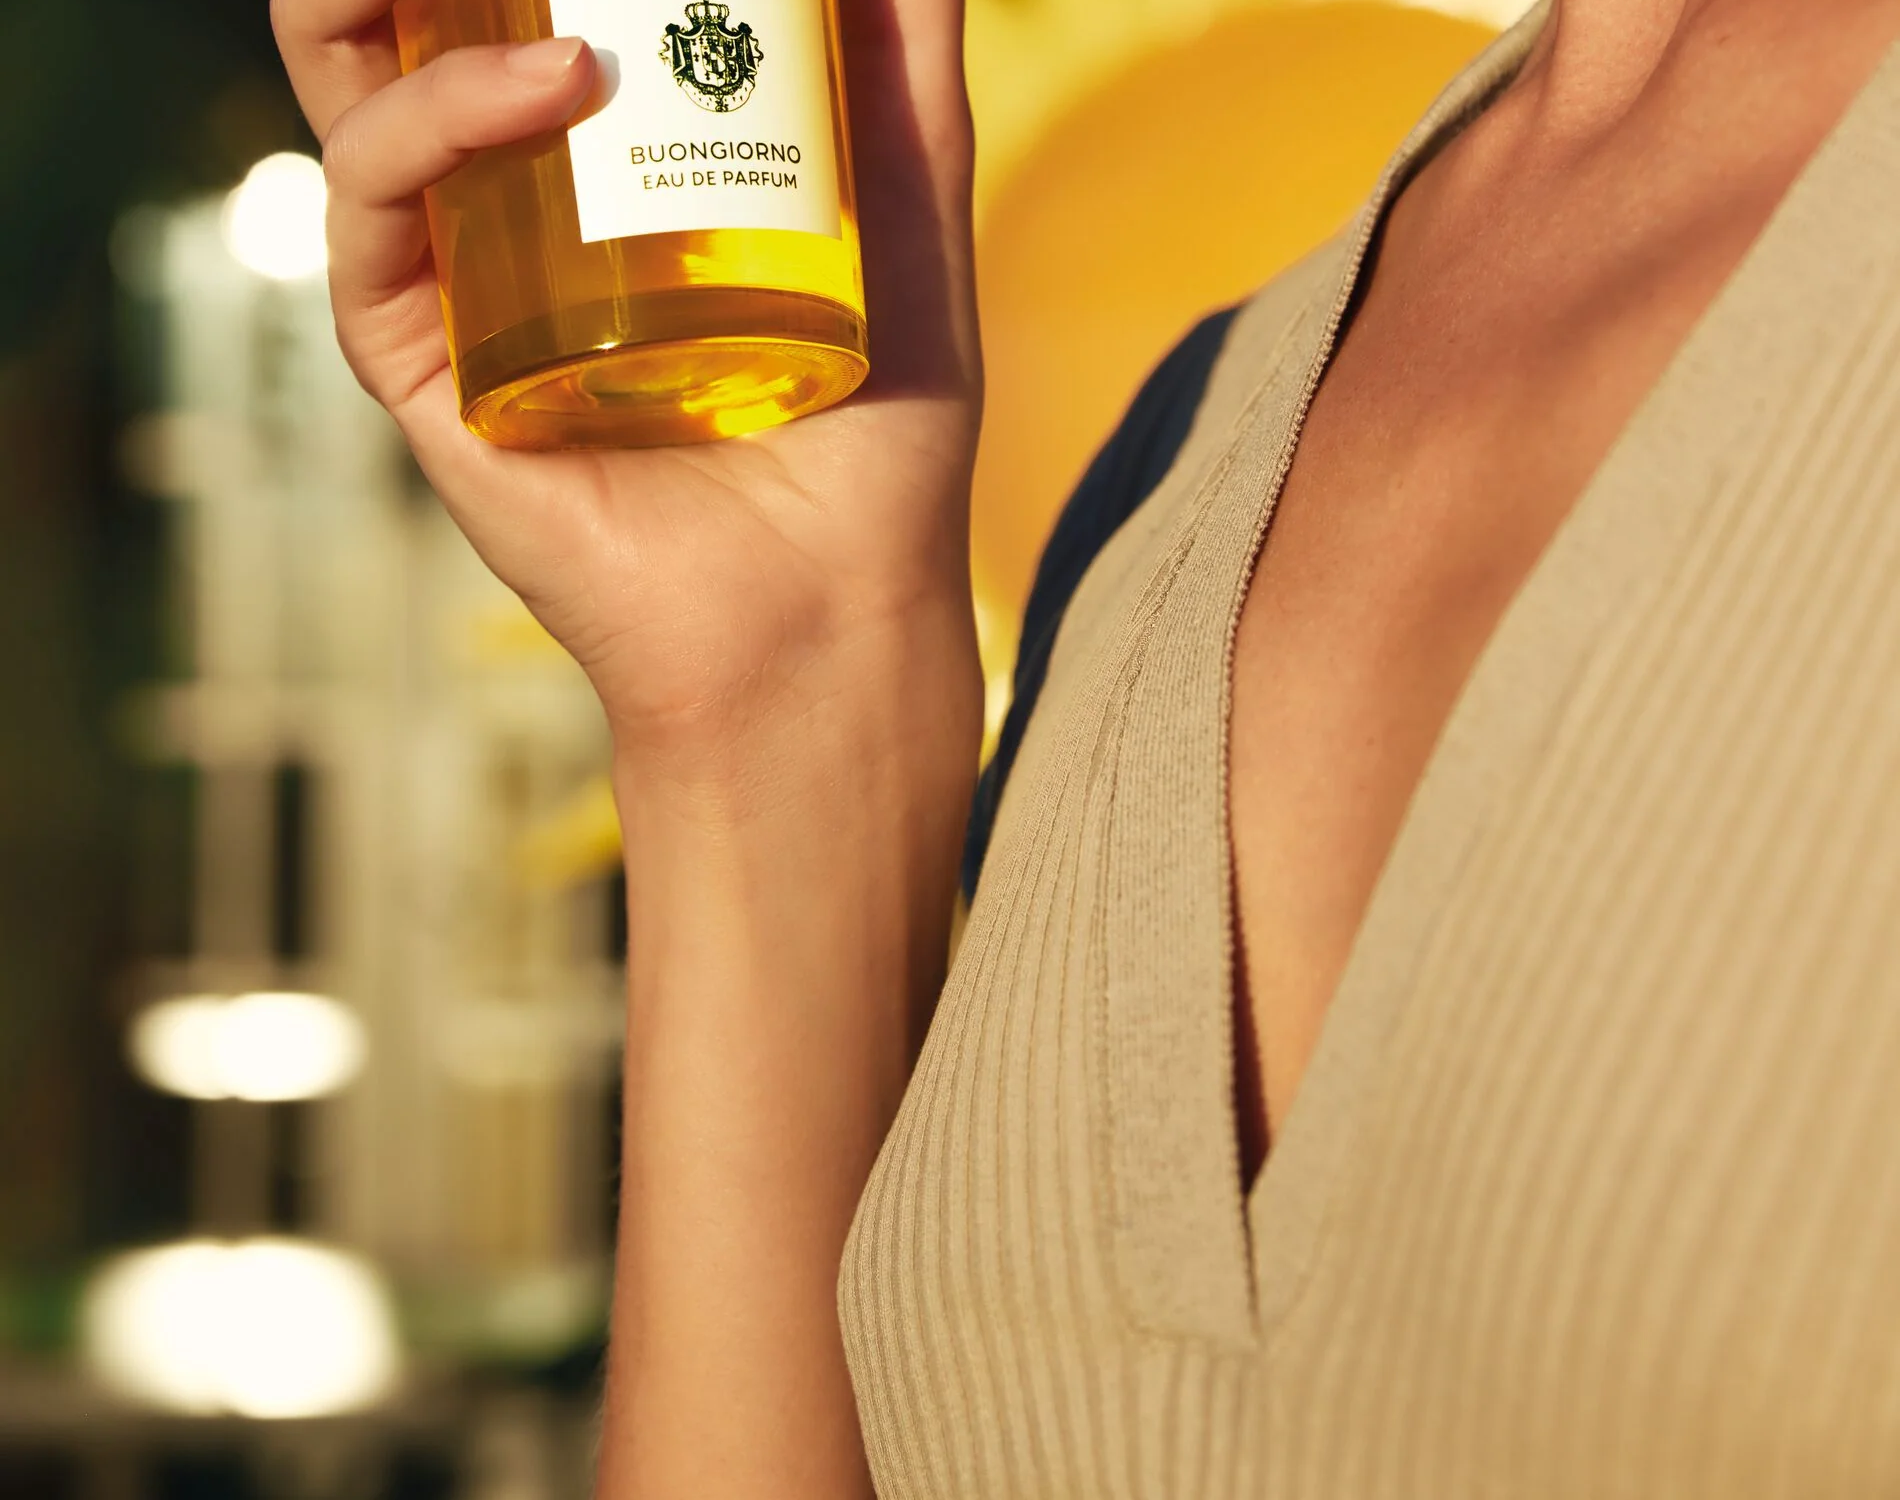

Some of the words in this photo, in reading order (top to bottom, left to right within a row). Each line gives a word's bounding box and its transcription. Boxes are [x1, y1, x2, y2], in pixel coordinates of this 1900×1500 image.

[630, 140, 802, 166] BUONGIORNO
[643, 172, 685, 190] EAU
[692, 171, 717, 188] DE
[723, 170, 798, 190] PARFUM
